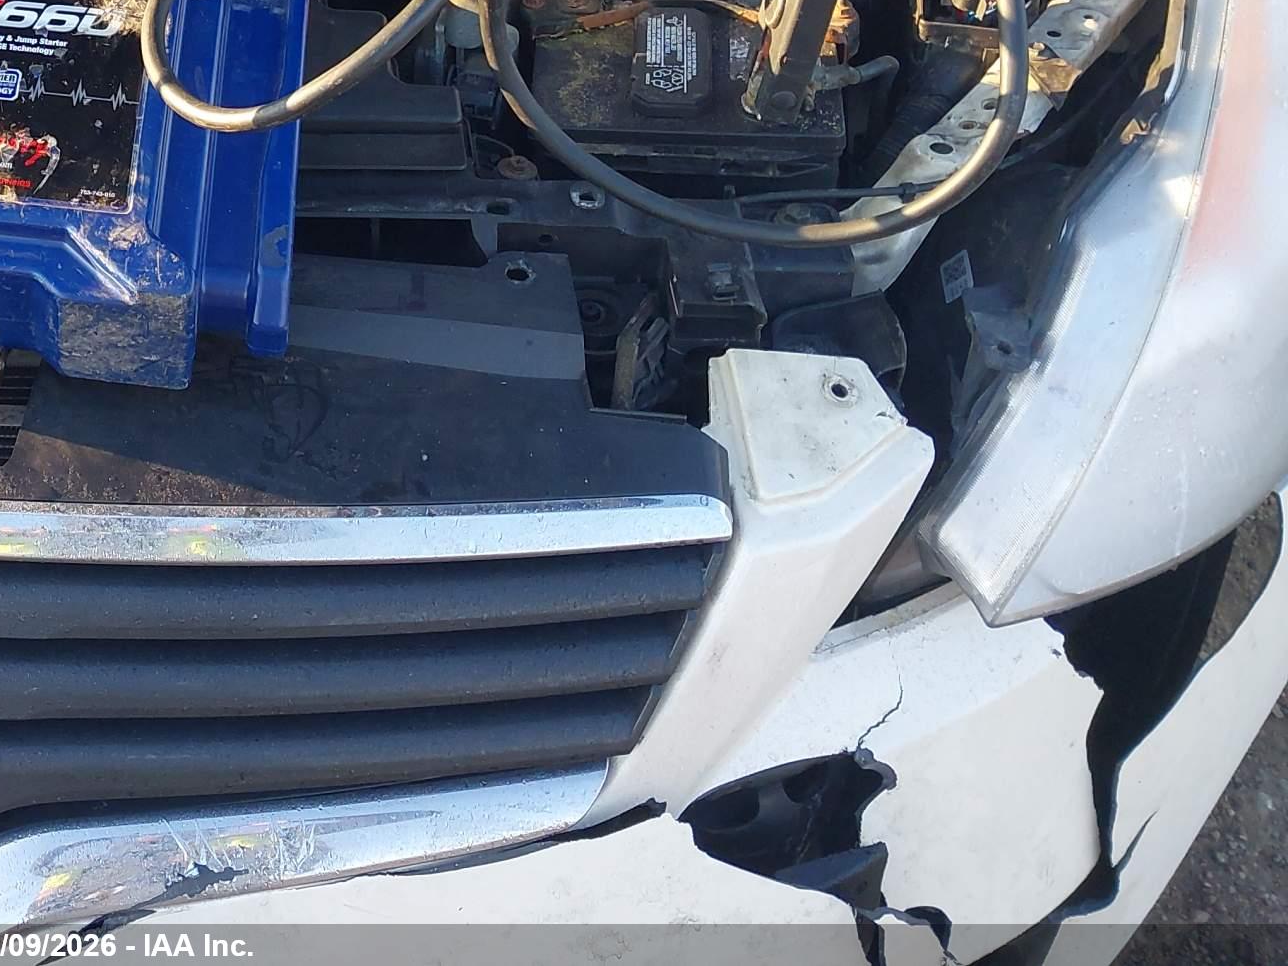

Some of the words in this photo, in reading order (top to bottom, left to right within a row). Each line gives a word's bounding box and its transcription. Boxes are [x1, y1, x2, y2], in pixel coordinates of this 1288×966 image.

[6, 34, 13, 42] &
[14, 35, 38, 45] Jump
[39, 38, 68, 47] Starter
[9, 44, 54, 55] Technology
